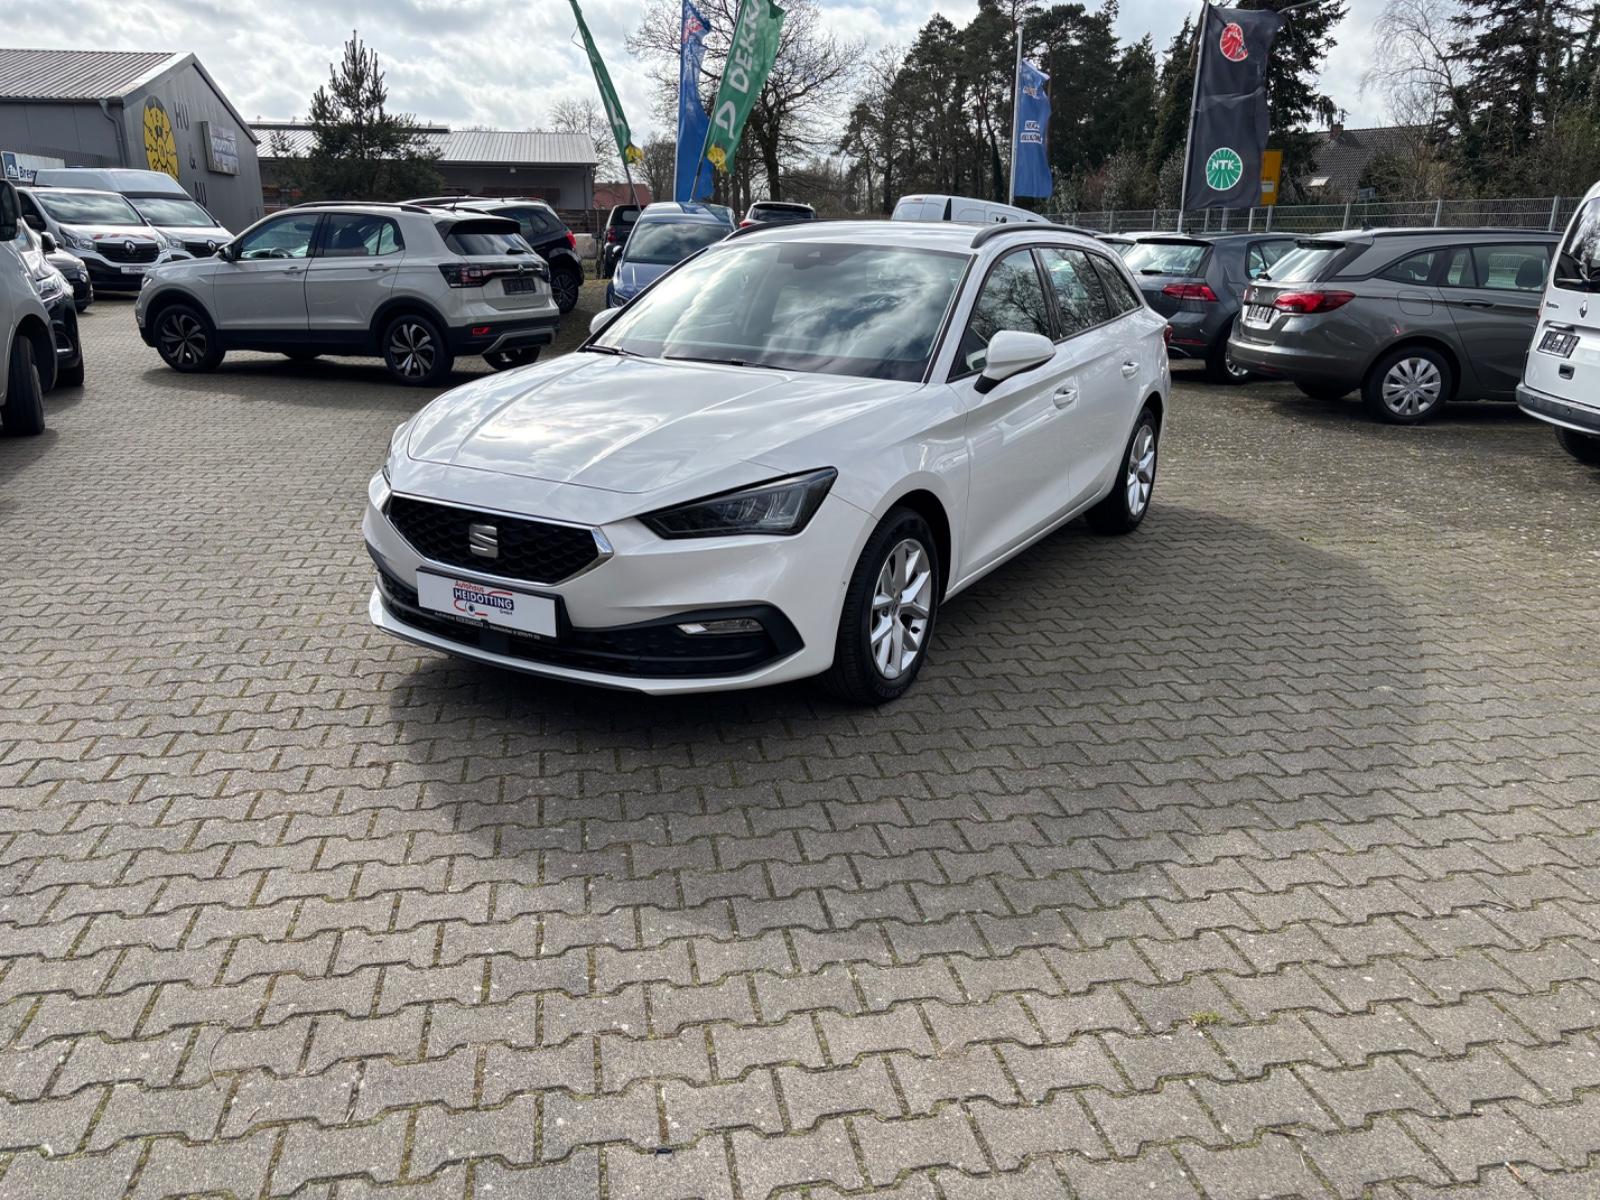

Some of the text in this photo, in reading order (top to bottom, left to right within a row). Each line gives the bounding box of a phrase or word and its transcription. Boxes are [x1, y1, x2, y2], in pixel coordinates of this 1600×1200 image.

[174, 101, 189, 131] HU
[1211, 159, 1235, 170] NTK
[454, 580, 485, 593] Autohaus
[454, 589, 513, 610] HEIDOTTING
